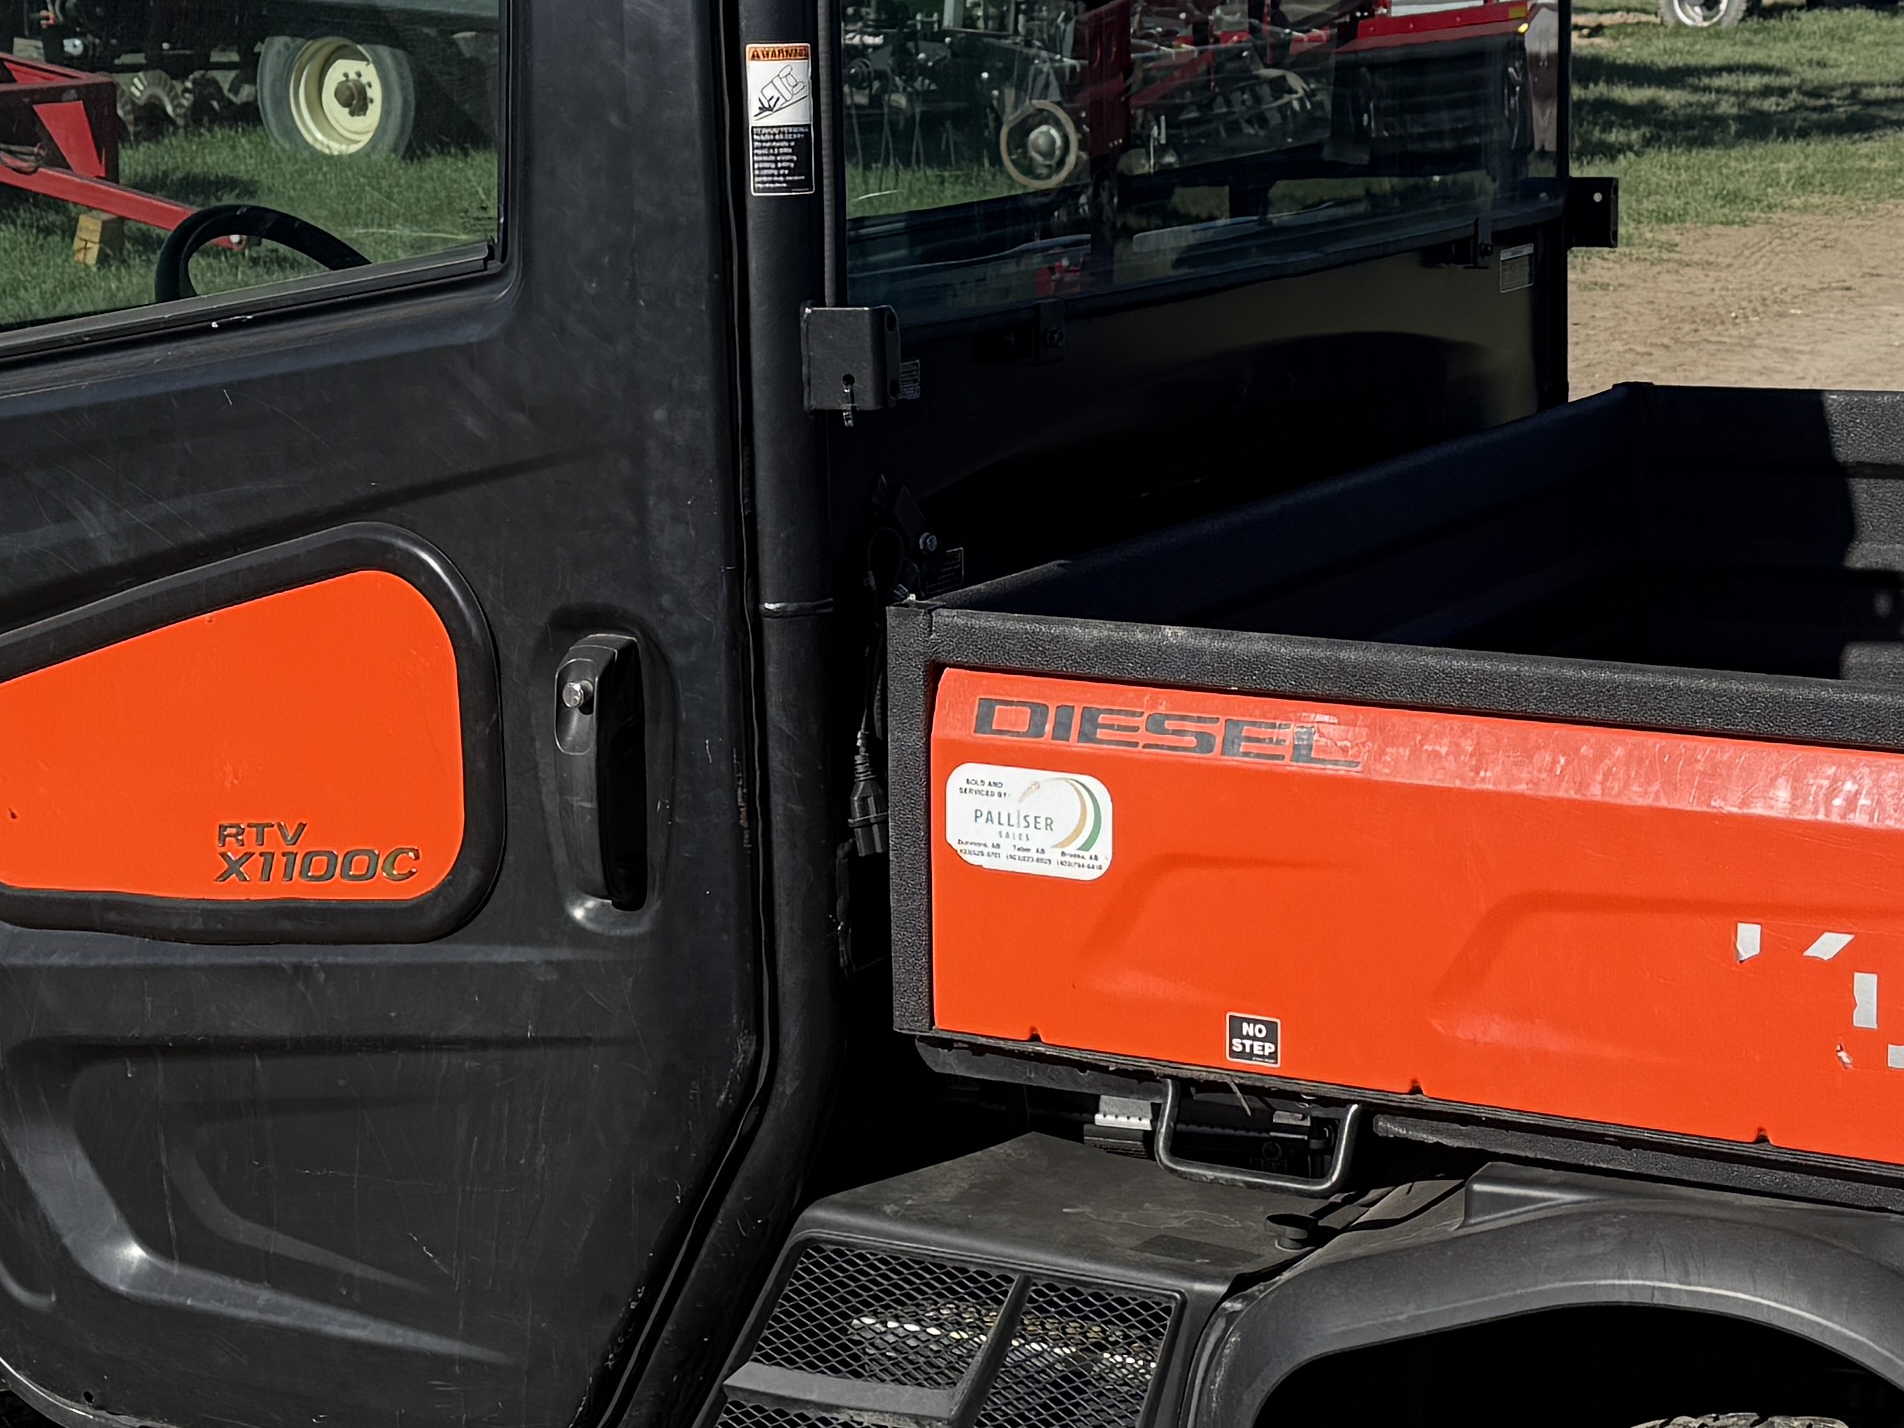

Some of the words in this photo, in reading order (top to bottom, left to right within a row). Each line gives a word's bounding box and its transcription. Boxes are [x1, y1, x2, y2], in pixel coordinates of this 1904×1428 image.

[972, 697, 1362, 768] DIESEL
[973, 808, 1054, 832] PALLISER
[217, 821, 308, 847] RTV
[998, 830, 1031, 843] SALES
[213, 846, 421, 882] X1100C
[1242, 1022, 1267, 1038] NO
[1231, 1038, 1276, 1056] STEP
